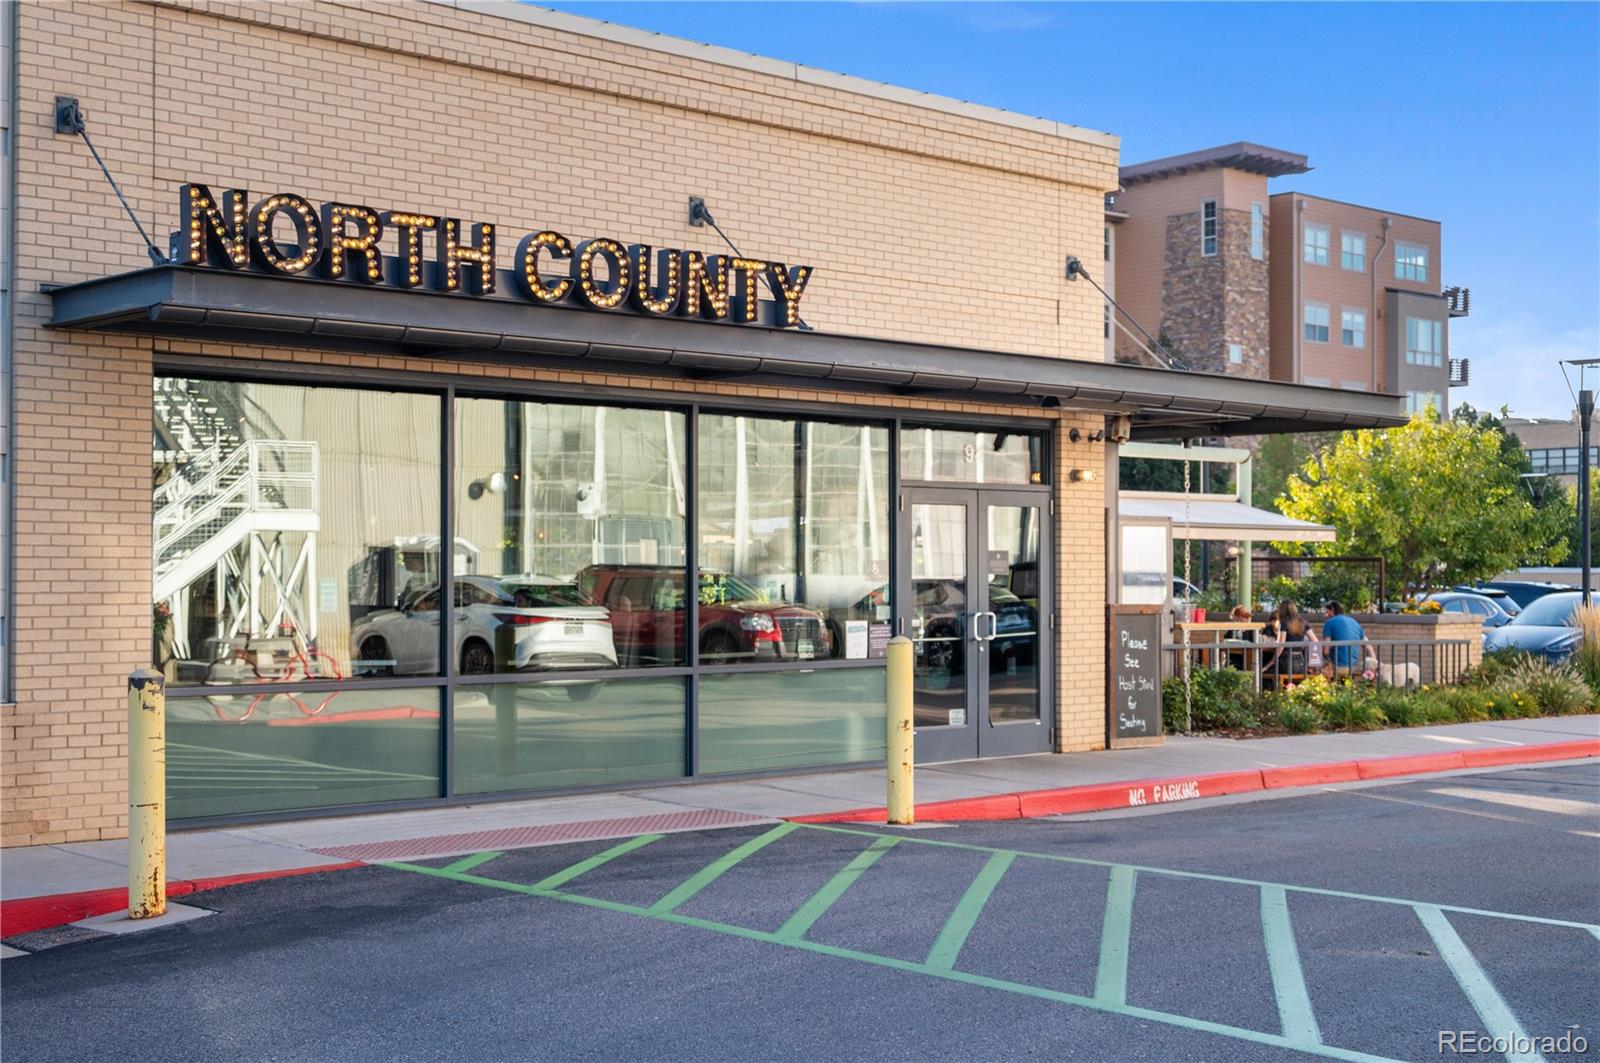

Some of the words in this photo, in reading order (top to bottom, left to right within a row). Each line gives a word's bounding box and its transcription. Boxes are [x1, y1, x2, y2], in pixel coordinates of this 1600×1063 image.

[180, 183, 496, 294] NORTH
[515, 230, 814, 327] COUNTY
[1121, 630, 1148, 650] Please
[1124, 653, 1140, 668] See
[1118, 674, 1136, 691] Host
[1128, 696, 1137, 709] for
[1119, 713, 1147, 732] Seating
[1128, 788, 1147, 806] NO
[1153, 780, 1200, 803] PARKING
